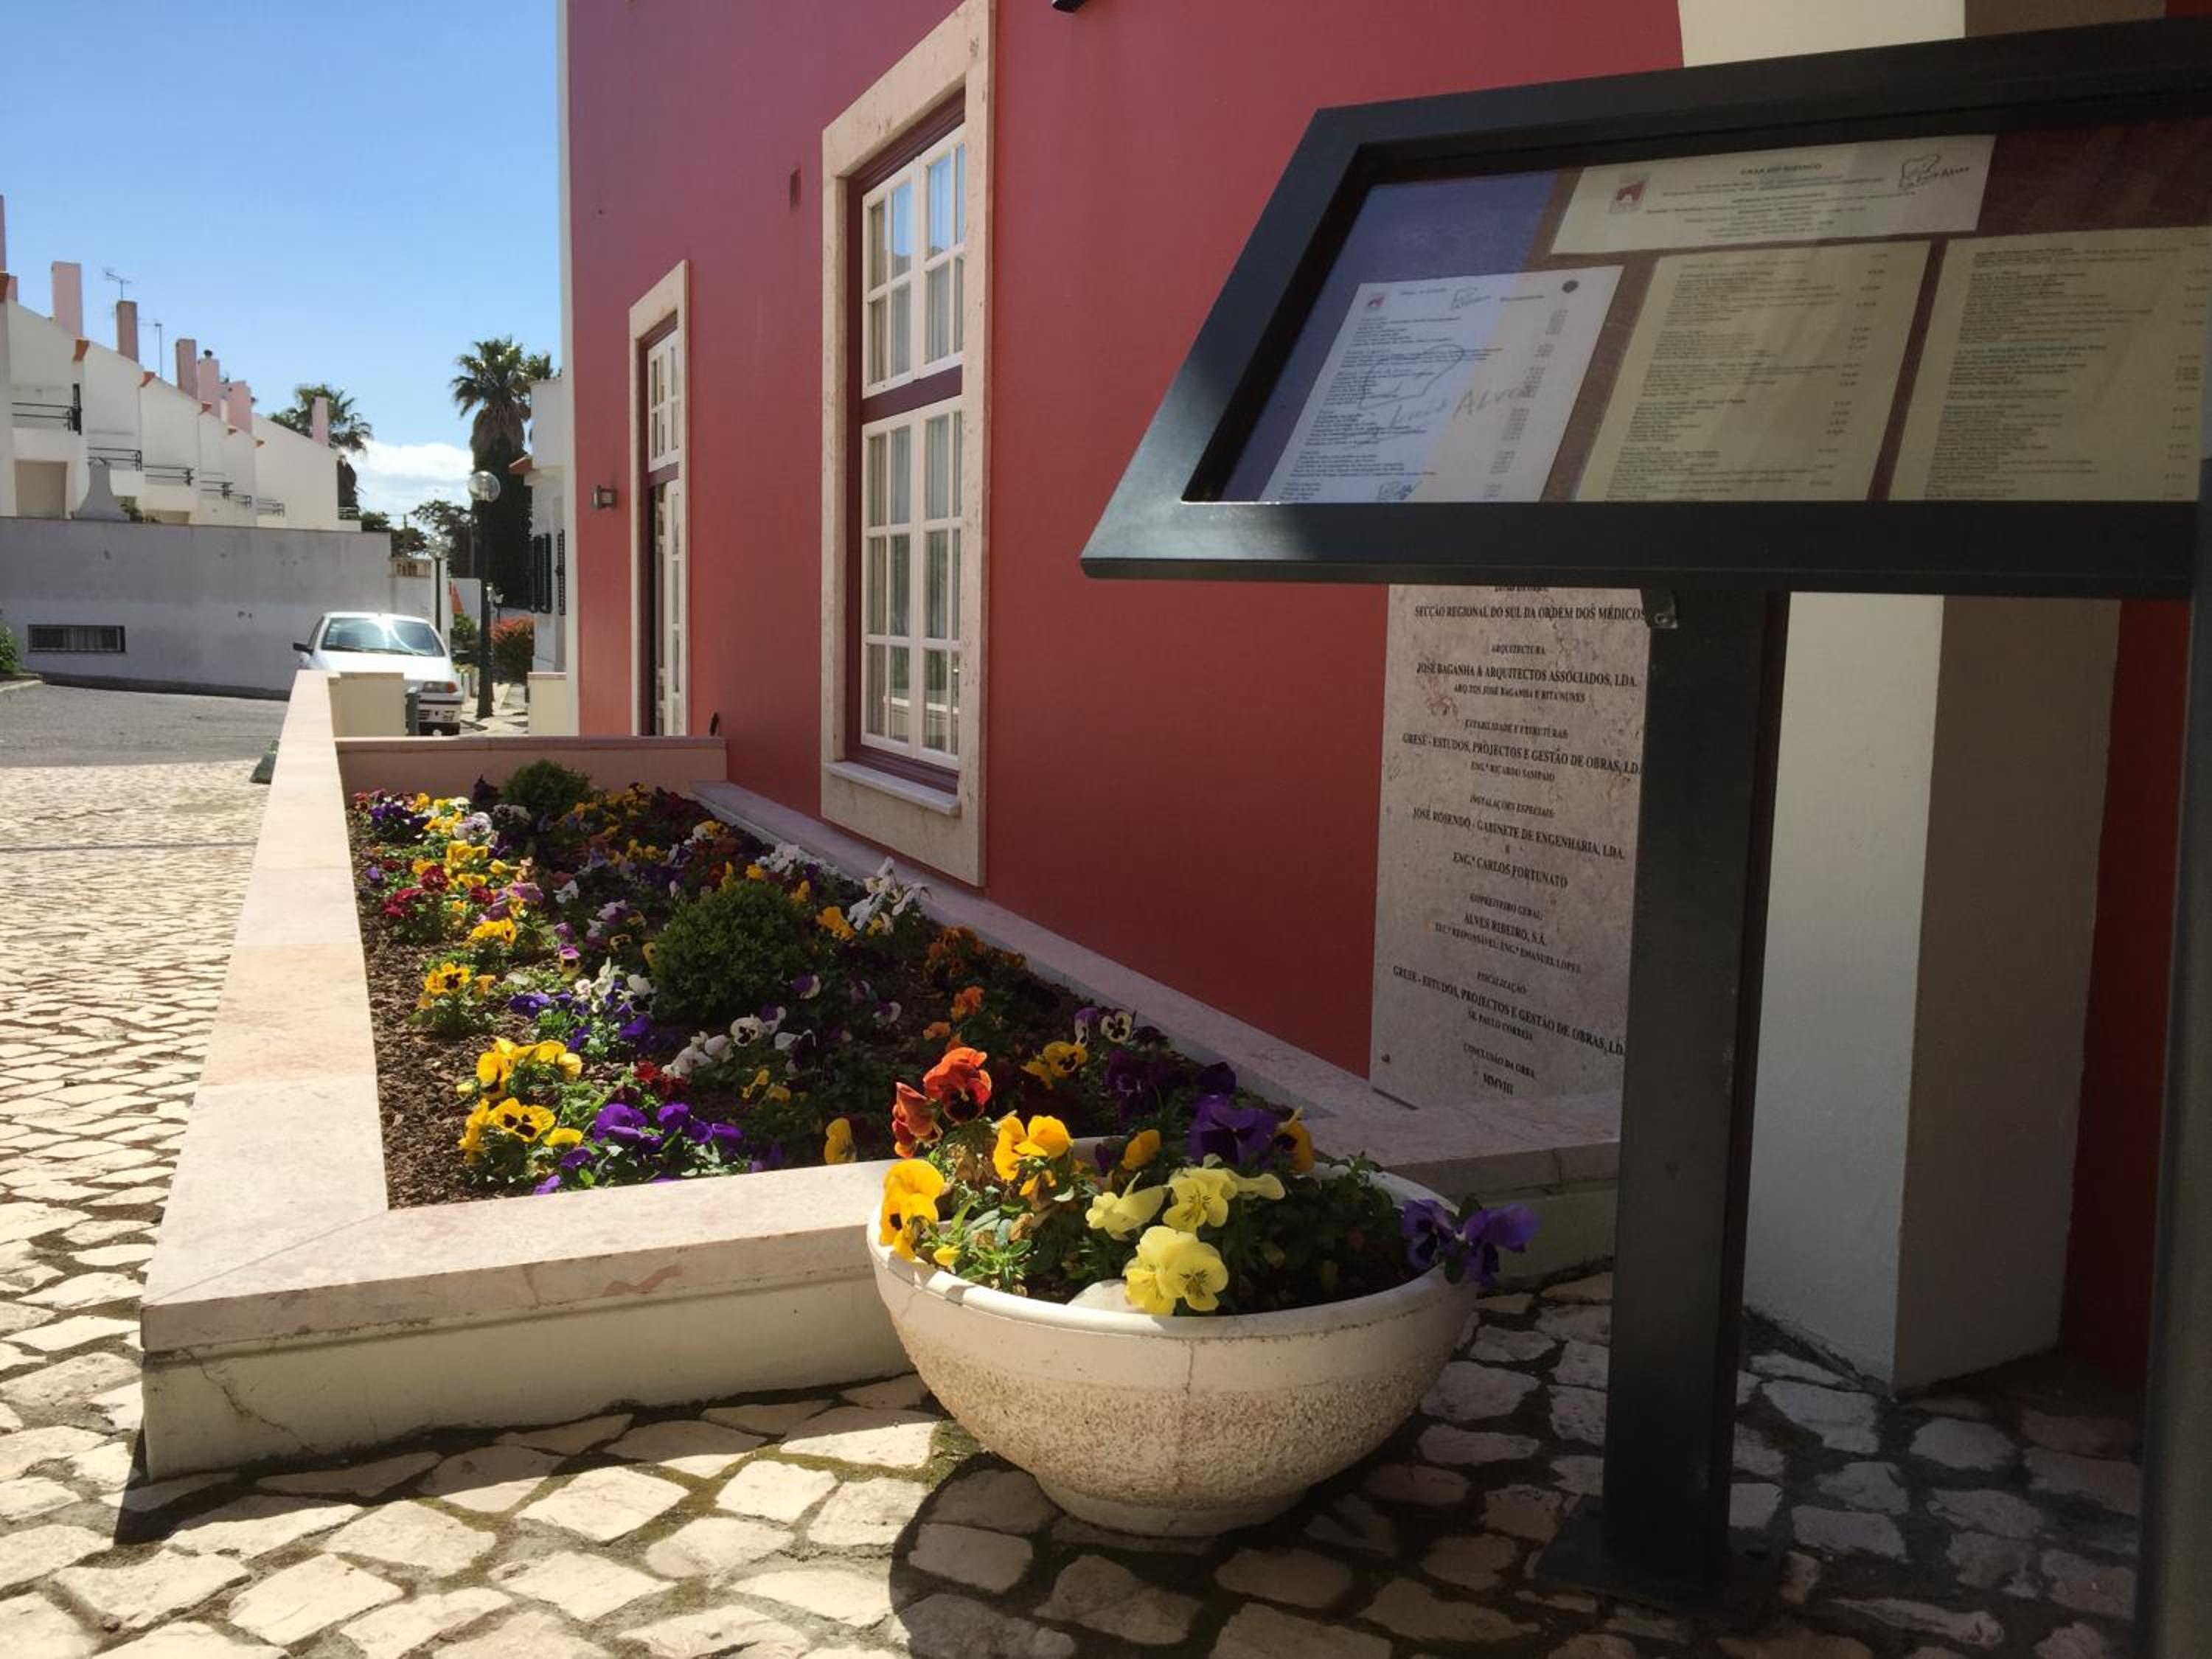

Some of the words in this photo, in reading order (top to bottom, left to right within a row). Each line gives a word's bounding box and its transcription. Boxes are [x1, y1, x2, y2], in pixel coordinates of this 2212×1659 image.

[1446, 606, 1488, 617] REGIONAL
[1490, 606, 1503, 618] DO
[1504, 606, 1521, 619] SUL
[1523, 607, 1536, 619] DA
[1538, 607, 1573, 620] ORDEM
[1576, 606, 1596, 620] DOS
[1437, 663, 1475, 676] BAGANHA
[1484, 666, 1547, 681] ARQUITECTOS
[1550, 670, 1613, 687] ASSOCIADOS,
[1614, 673, 1638, 687] LDA.
[1472, 742, 1522, 759] PROJECTOS
[1524, 748, 1530, 759] E
[1531, 747, 1568, 765] GESTÃO
[1570, 754, 1584, 767] DE
[1585, 756, 1621, 776] OBRAS,
[1520, 828, 1534, 842] DE
[1535, 831, 1601, 856] ENGENHARIA,
[1477, 857, 1511, 875] CARLOS
[1511, 864, 1568, 888] FORTUNATO
[1464, 912, 1490, 929] ALVES
[1460, 989, 1509, 1015] PROJECTOS
[1556, 1022, 1570, 1037] DE
